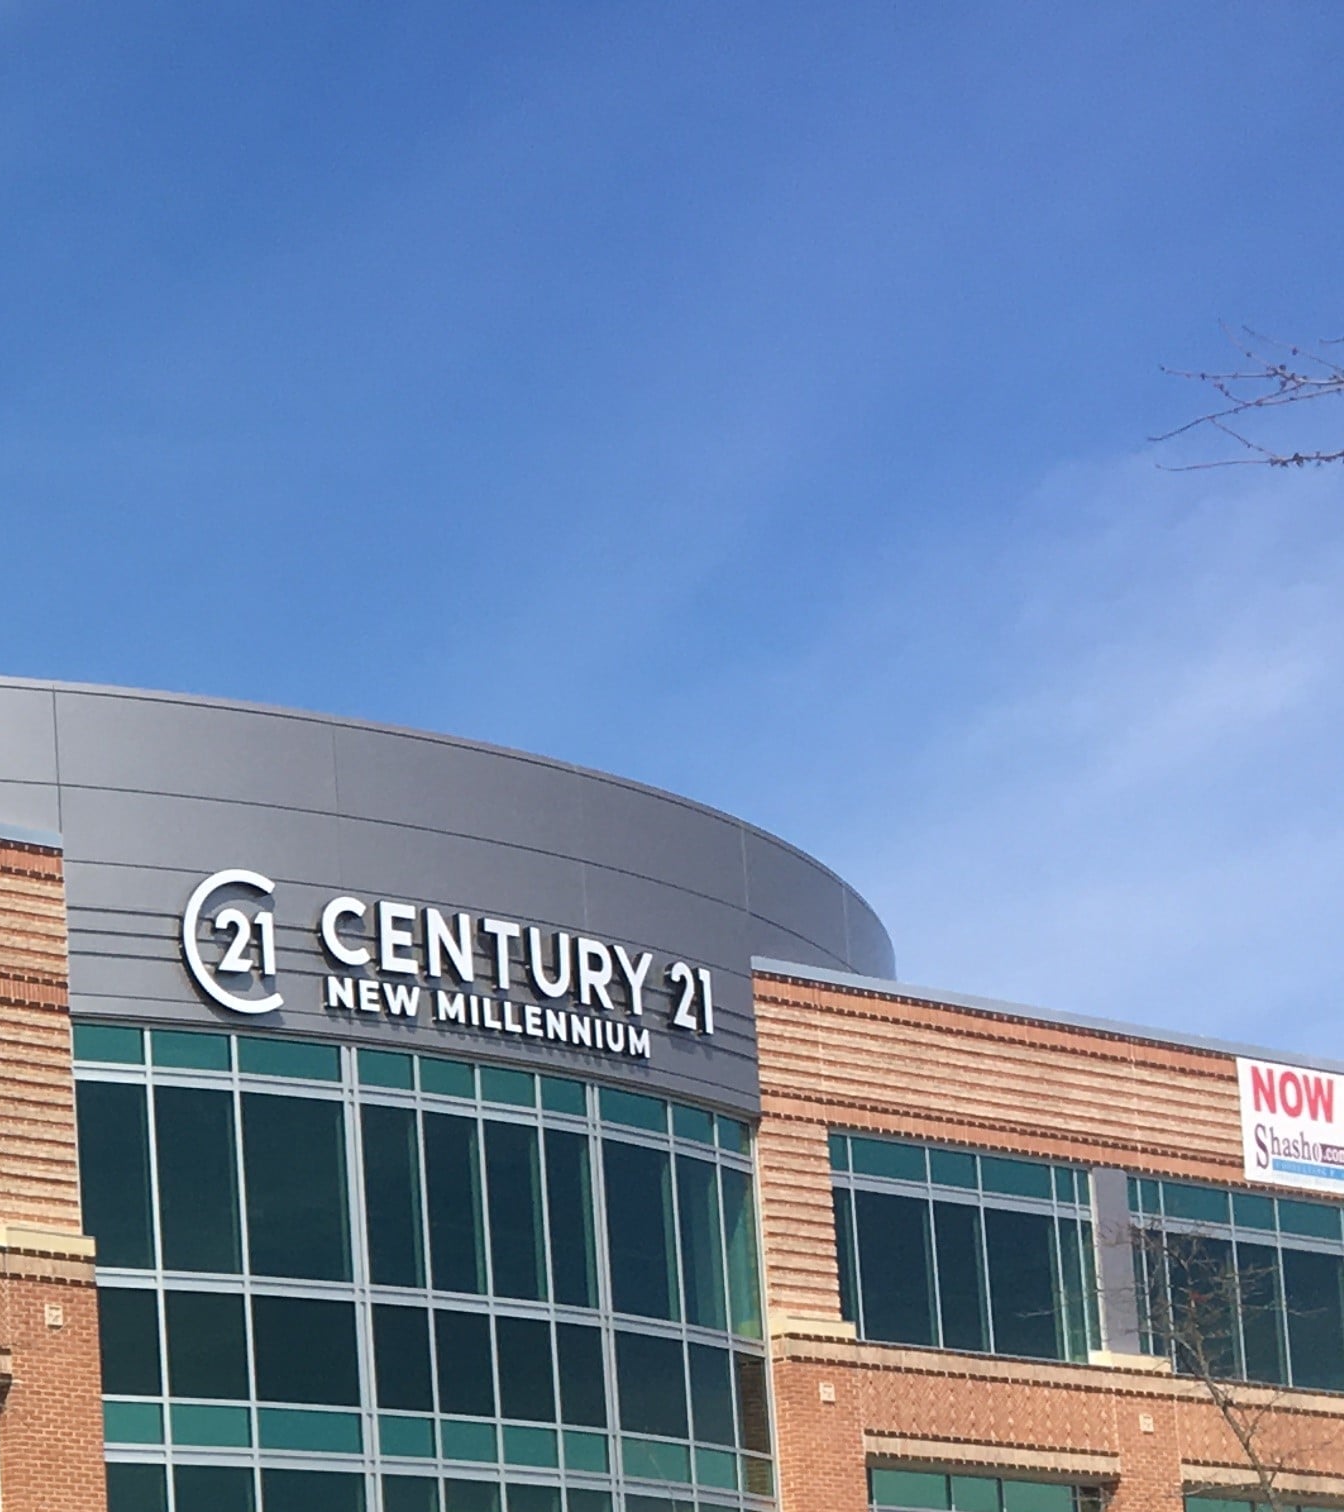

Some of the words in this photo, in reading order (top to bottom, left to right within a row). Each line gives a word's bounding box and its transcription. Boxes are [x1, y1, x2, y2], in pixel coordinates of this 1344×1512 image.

[321, 896, 653, 1016] CENTURY
[669, 961, 714, 1035] 21
[326, 975, 420, 1017] NEW
[435, 990, 651, 1059] MILLENNIUM
[1250, 1065, 1334, 1124] NOW
